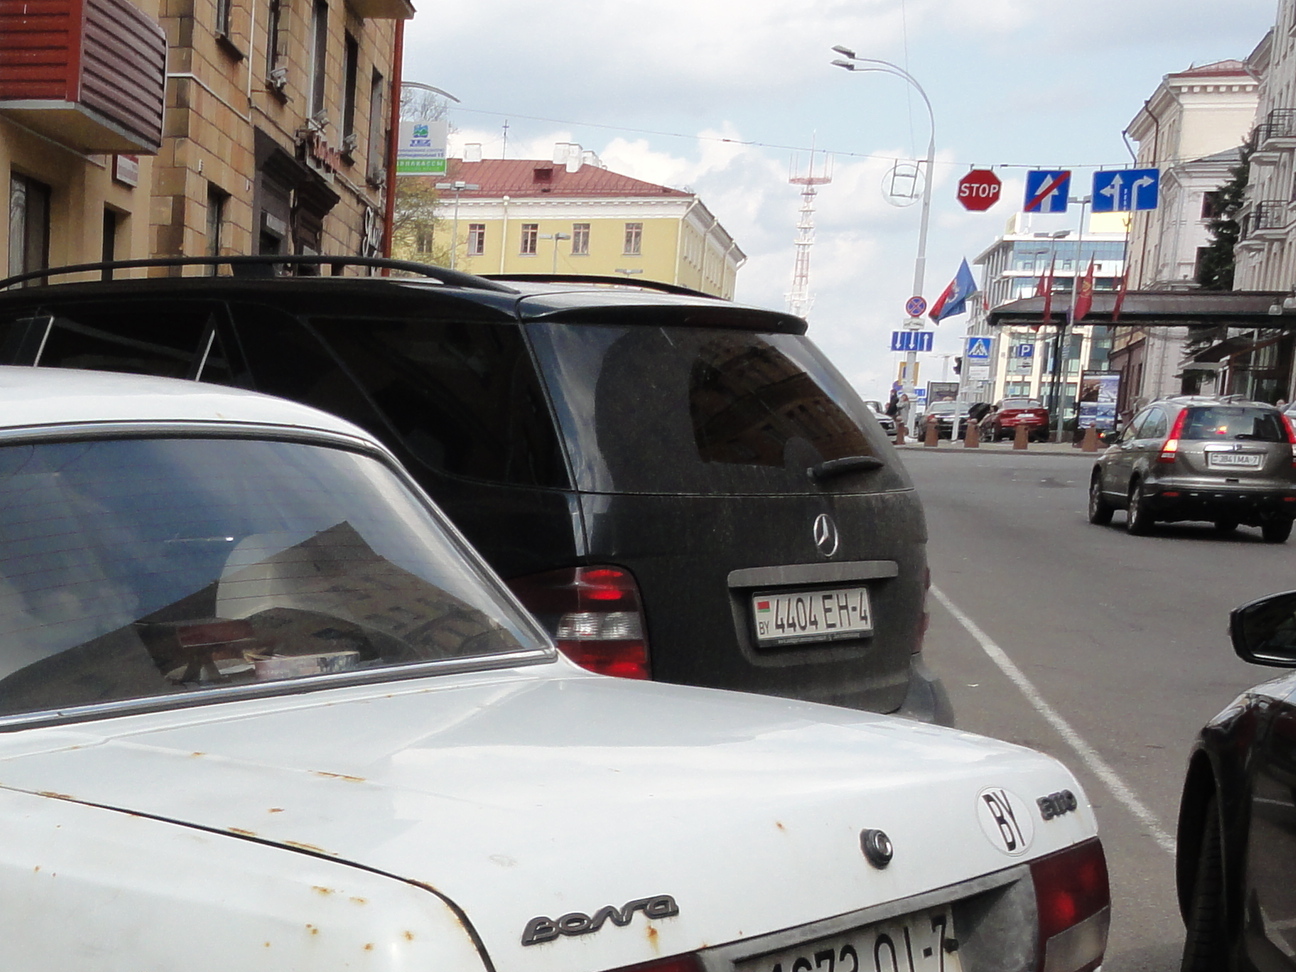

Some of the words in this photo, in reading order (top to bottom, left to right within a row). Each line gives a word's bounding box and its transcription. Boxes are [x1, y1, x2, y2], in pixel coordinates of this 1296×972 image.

[959, 183, 999, 198] STOP
[775, 597, 818, 634] 4404
[822, 591, 868, 629] EH-4
[758, 620, 770, 635] BY
[982, 790, 1026, 852] BY
